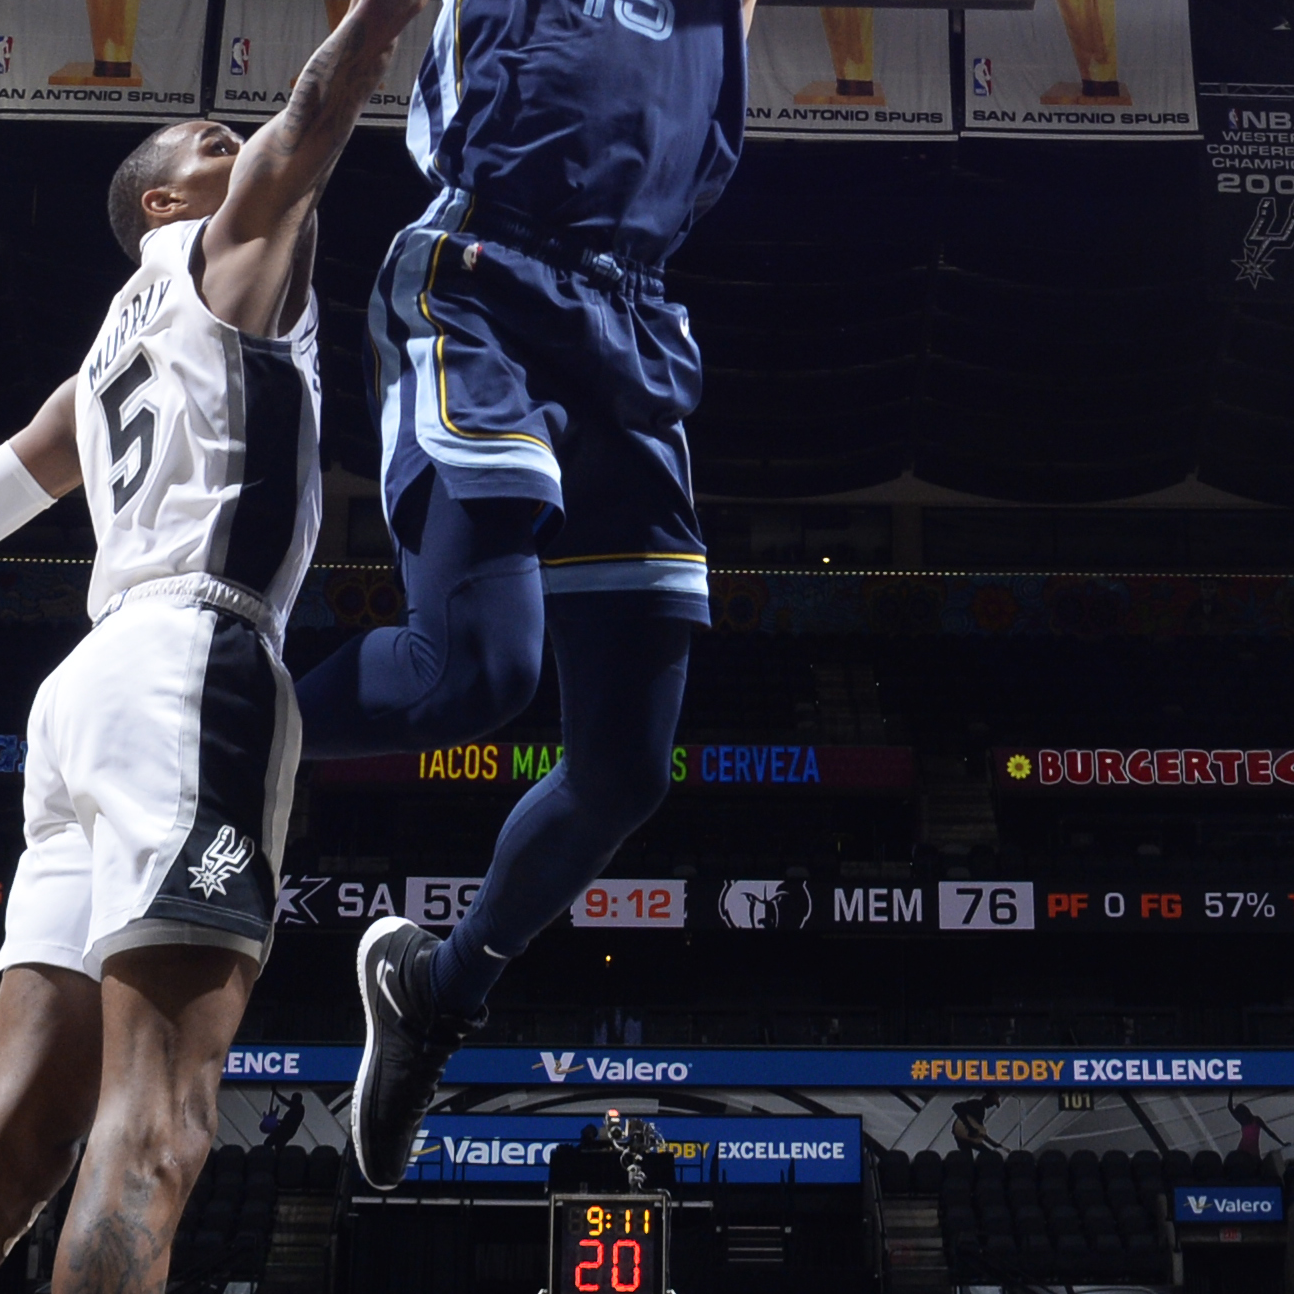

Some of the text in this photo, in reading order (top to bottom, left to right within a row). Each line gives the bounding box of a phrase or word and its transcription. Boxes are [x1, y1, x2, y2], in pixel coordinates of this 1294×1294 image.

[30, 88, 124, 103] ANTONIO
[127, 90, 195, 105] SPURS
[225, 89, 267, 102] SAN
[369, 93, 411, 106] SPU
[746, 107, 943, 124] AN ANTONIO SPURS
[973, 109, 1190, 126] SAN ANTONIO SPURS
[97, 343, 159, 516] 5
[700, 746, 821, 783] CERVEZA
[337, 883, 396, 917] SA
[585, 888, 672, 919] 9:12
[833, 888, 924, 922] MEM
[955, 888, 1019, 926] 76
[1046, 893, 1089, 918] PF
[1104, 892, 1126, 918] 0
[1140, 893, 1183, 918] FG
[1204, 892, 1276, 919] 57%
[586, 1056, 688, 1082] Valero
[910, 1059, 1243, 1081] #FUELEDBY EXCELLENCE
[1060, 1092, 1093, 1110] 101
[717, 1141, 845, 1160] EXCELLENCE
[1213, 1197, 1272, 1214] Valero
[586, 1205, 650, 1236] 9:11
[574, 1238, 641, 1293] 20
